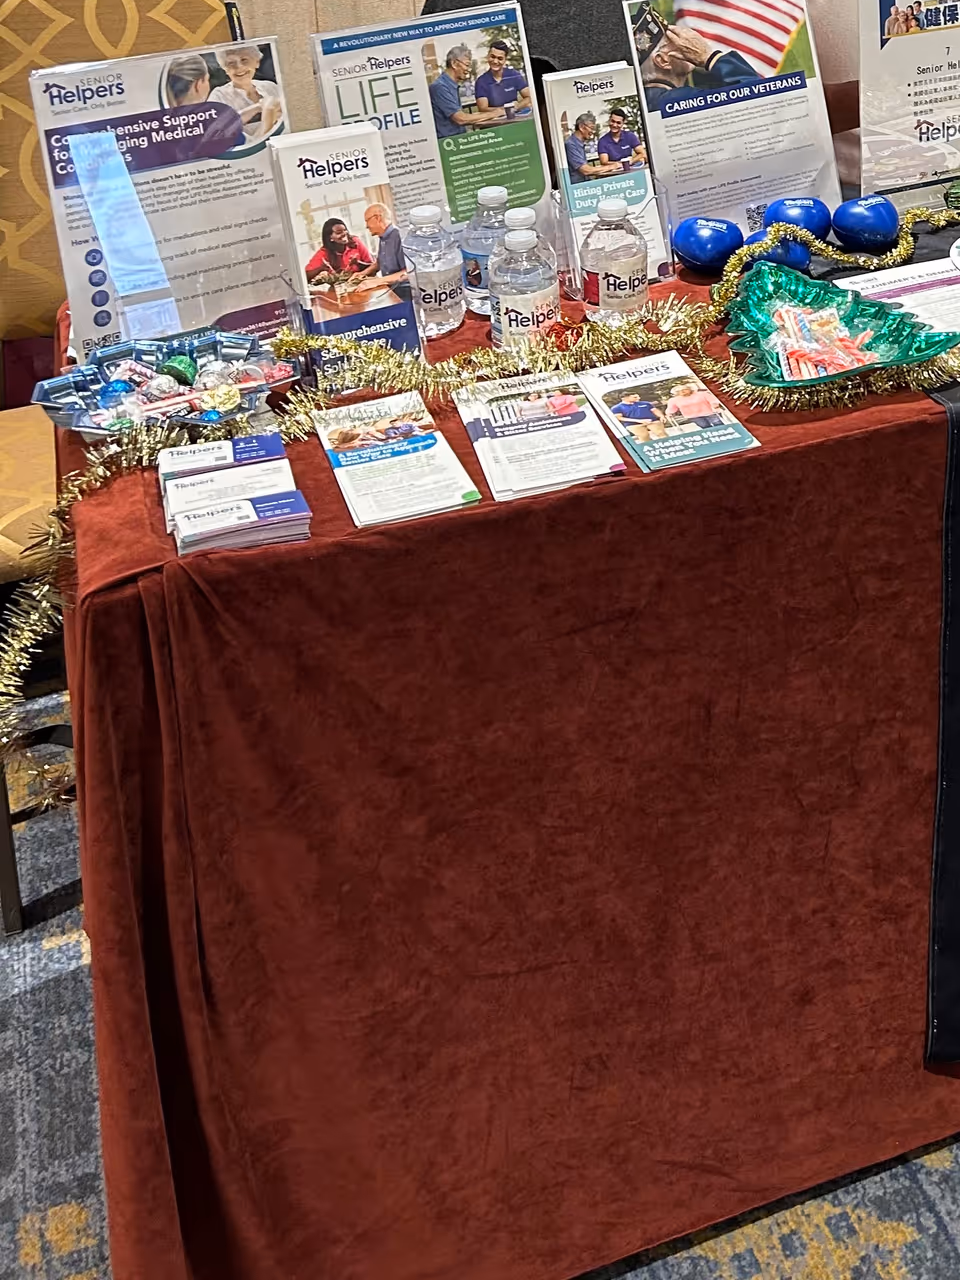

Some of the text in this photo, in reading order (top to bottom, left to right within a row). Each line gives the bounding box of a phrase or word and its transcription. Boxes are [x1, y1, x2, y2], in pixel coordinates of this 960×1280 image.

[339, 33, 392, 48] REVOLUTIONARY
[392, 30, 408, 39] NEW
[409, 28, 424, 36] WAY
[434, 21, 467, 32] APPROACH
[467, 17, 490, 26] SENIOR
[490, 14, 506, 22] CARE
[945, 46, 951, 56] 7
[332, 56, 411, 78] SENIOR Helpers
[916, 63, 944, 75] Senior
[80, 73, 123, 88] SENIOR
[576, 80, 615, 94] Helpers
[50, 82, 125, 106] Helpers
[335, 72, 419, 119] LIFE
[665, 76, 802, 113] CARING FOR OUR VETERANS
[51, 108, 218, 147] Cohensive Support
[151, 123, 205, 144] Medical
[328, 147, 368, 162] SENIOR
[303, 155, 369, 180] Helpers
[573, 179, 635, 198] Hiring Private
[575, 197, 598, 209] Duty
[625, 188, 646, 198] Care
[606, 273, 648, 293] Helpe
[421, 286, 463, 307] elpers
[330, 318, 407, 341] prehensive
[603, 363, 671, 383] Helpers
[345, 441, 409, 457] Revolutionary
[642, 427, 737, 452] A Helping Hand
[645, 432, 742, 458] When You Need
[650, 448, 697, 462] It Most
